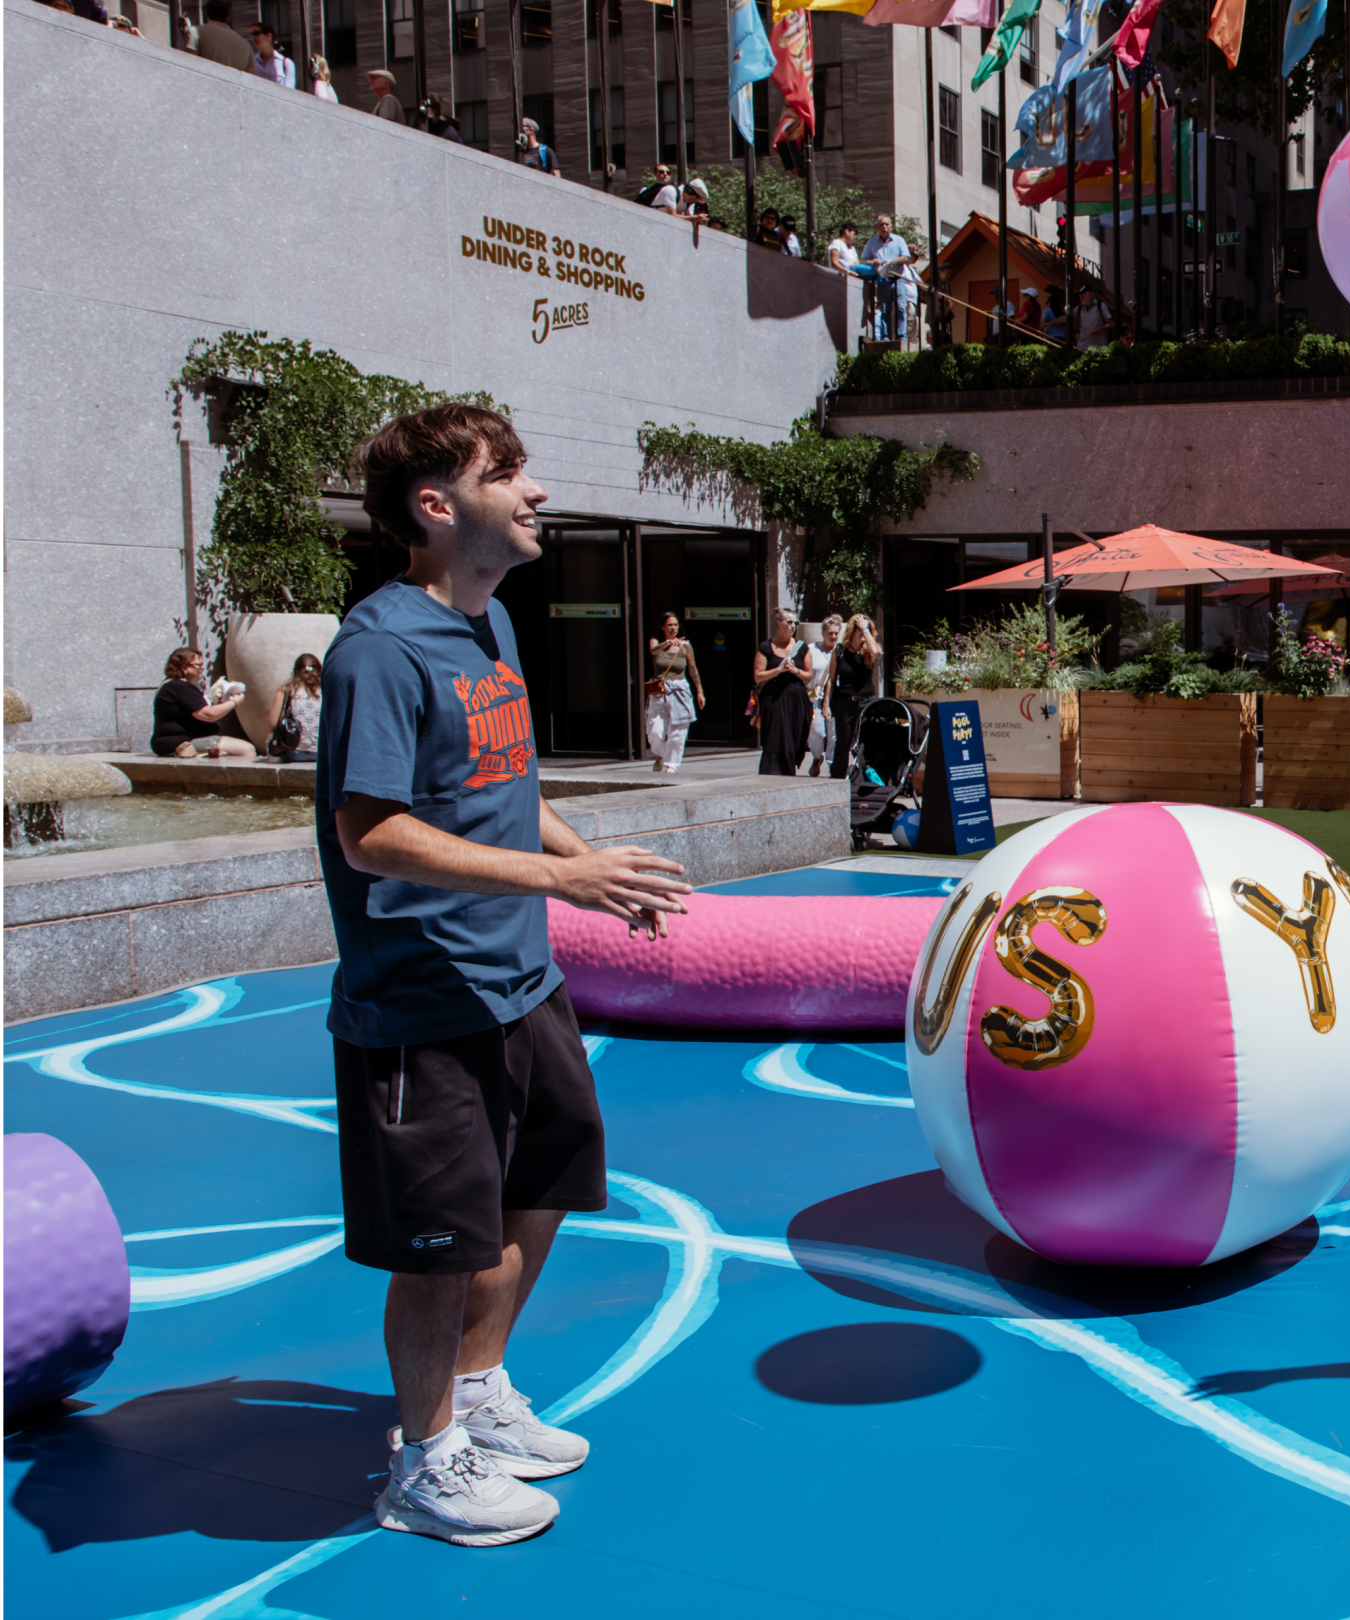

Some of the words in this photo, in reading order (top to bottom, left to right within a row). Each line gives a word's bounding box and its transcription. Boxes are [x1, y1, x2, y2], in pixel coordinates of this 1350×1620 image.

[483, 215, 548, 253] UNDER
[551, 235, 575, 260] 30
[579, 242, 627, 275] ROCK
[1226, 233, 1234, 244] 50
[461, 234, 533, 273] DINING
[536, 256, 551, 278] &
[555, 260, 646, 302] SHOPPING
[531, 298, 550, 345] 5
[552, 302, 589, 327] ACRES
[466, 695, 531, 760] PUMA
[952, 715, 971, 729] POOL
[952, 727, 973, 741] PARTY
